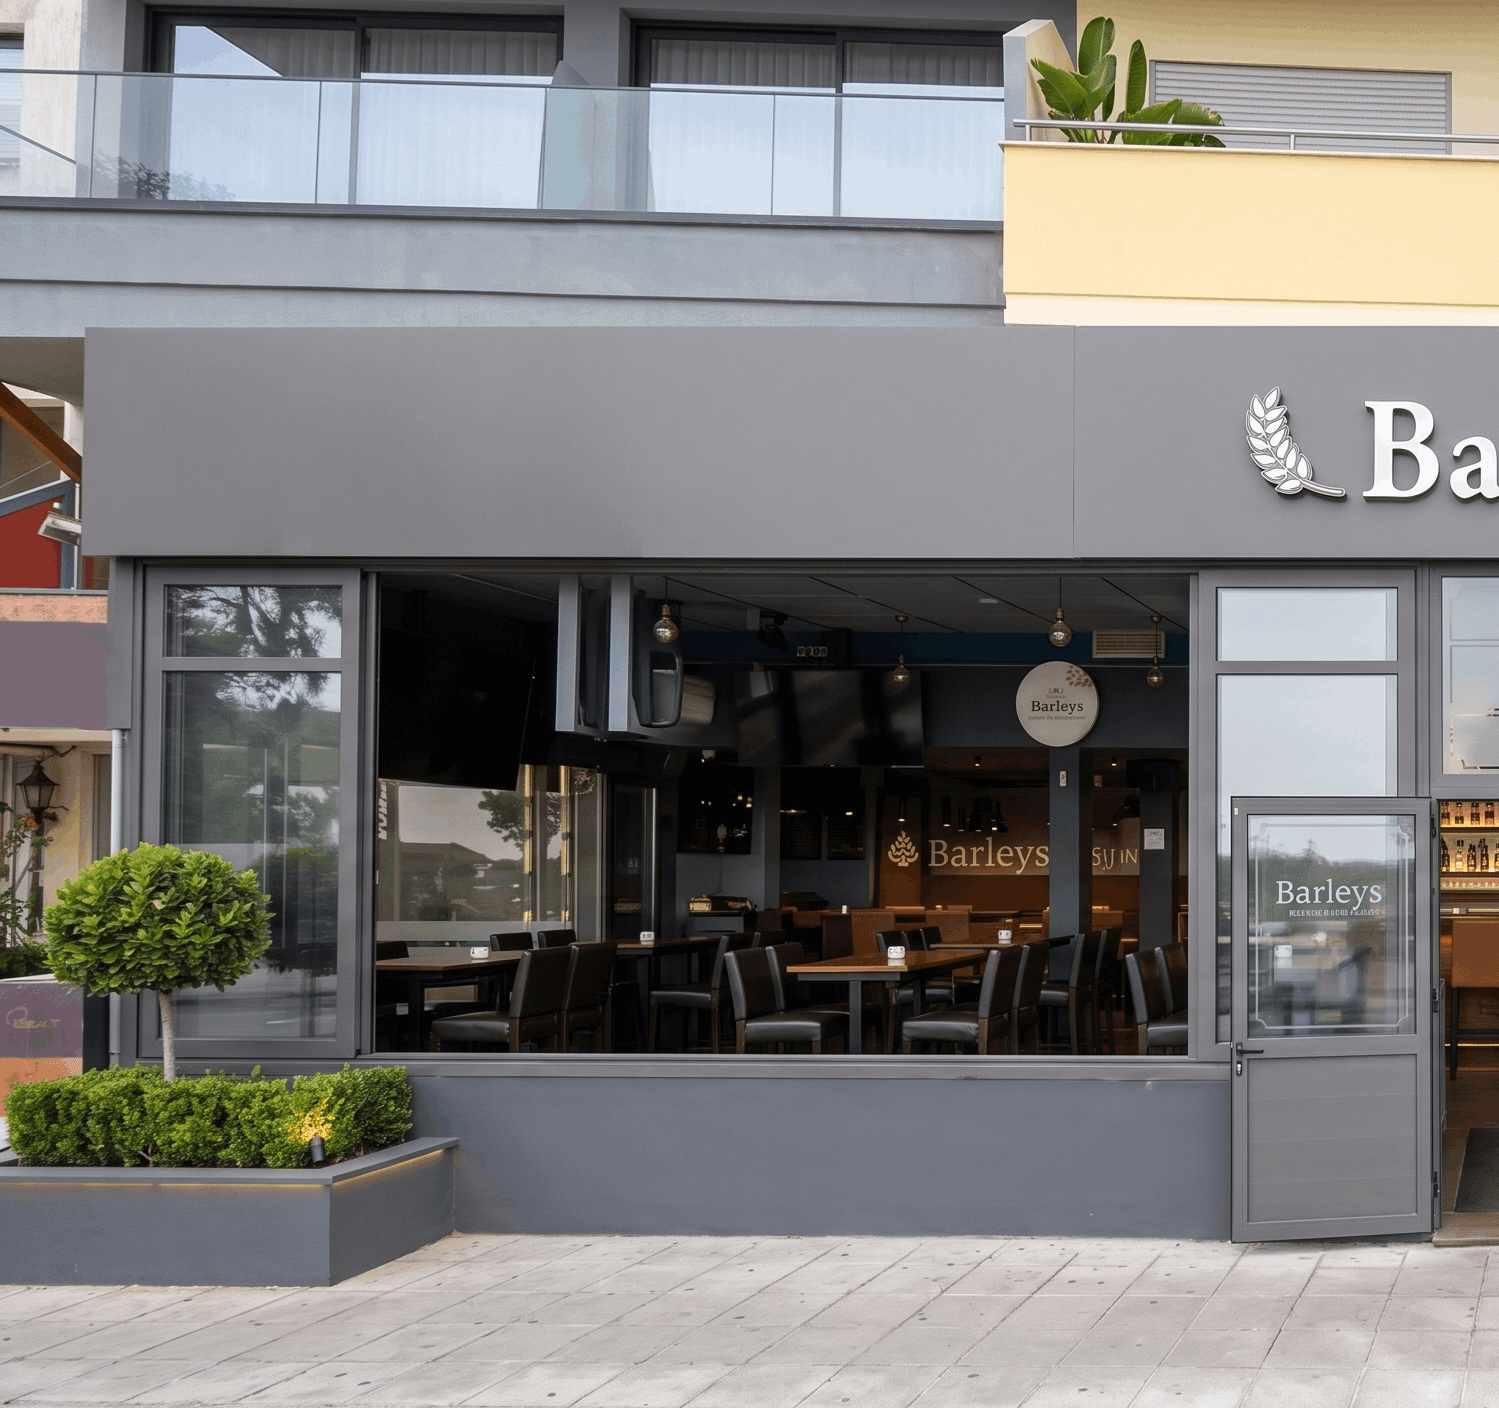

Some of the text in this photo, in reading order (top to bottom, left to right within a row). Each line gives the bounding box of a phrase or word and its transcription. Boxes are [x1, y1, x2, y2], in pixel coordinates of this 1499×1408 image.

[1031, 700, 1084, 715] Barleys
[928, 836, 1050, 875] Barleys
[1275, 878, 1383, 911] Barleys
